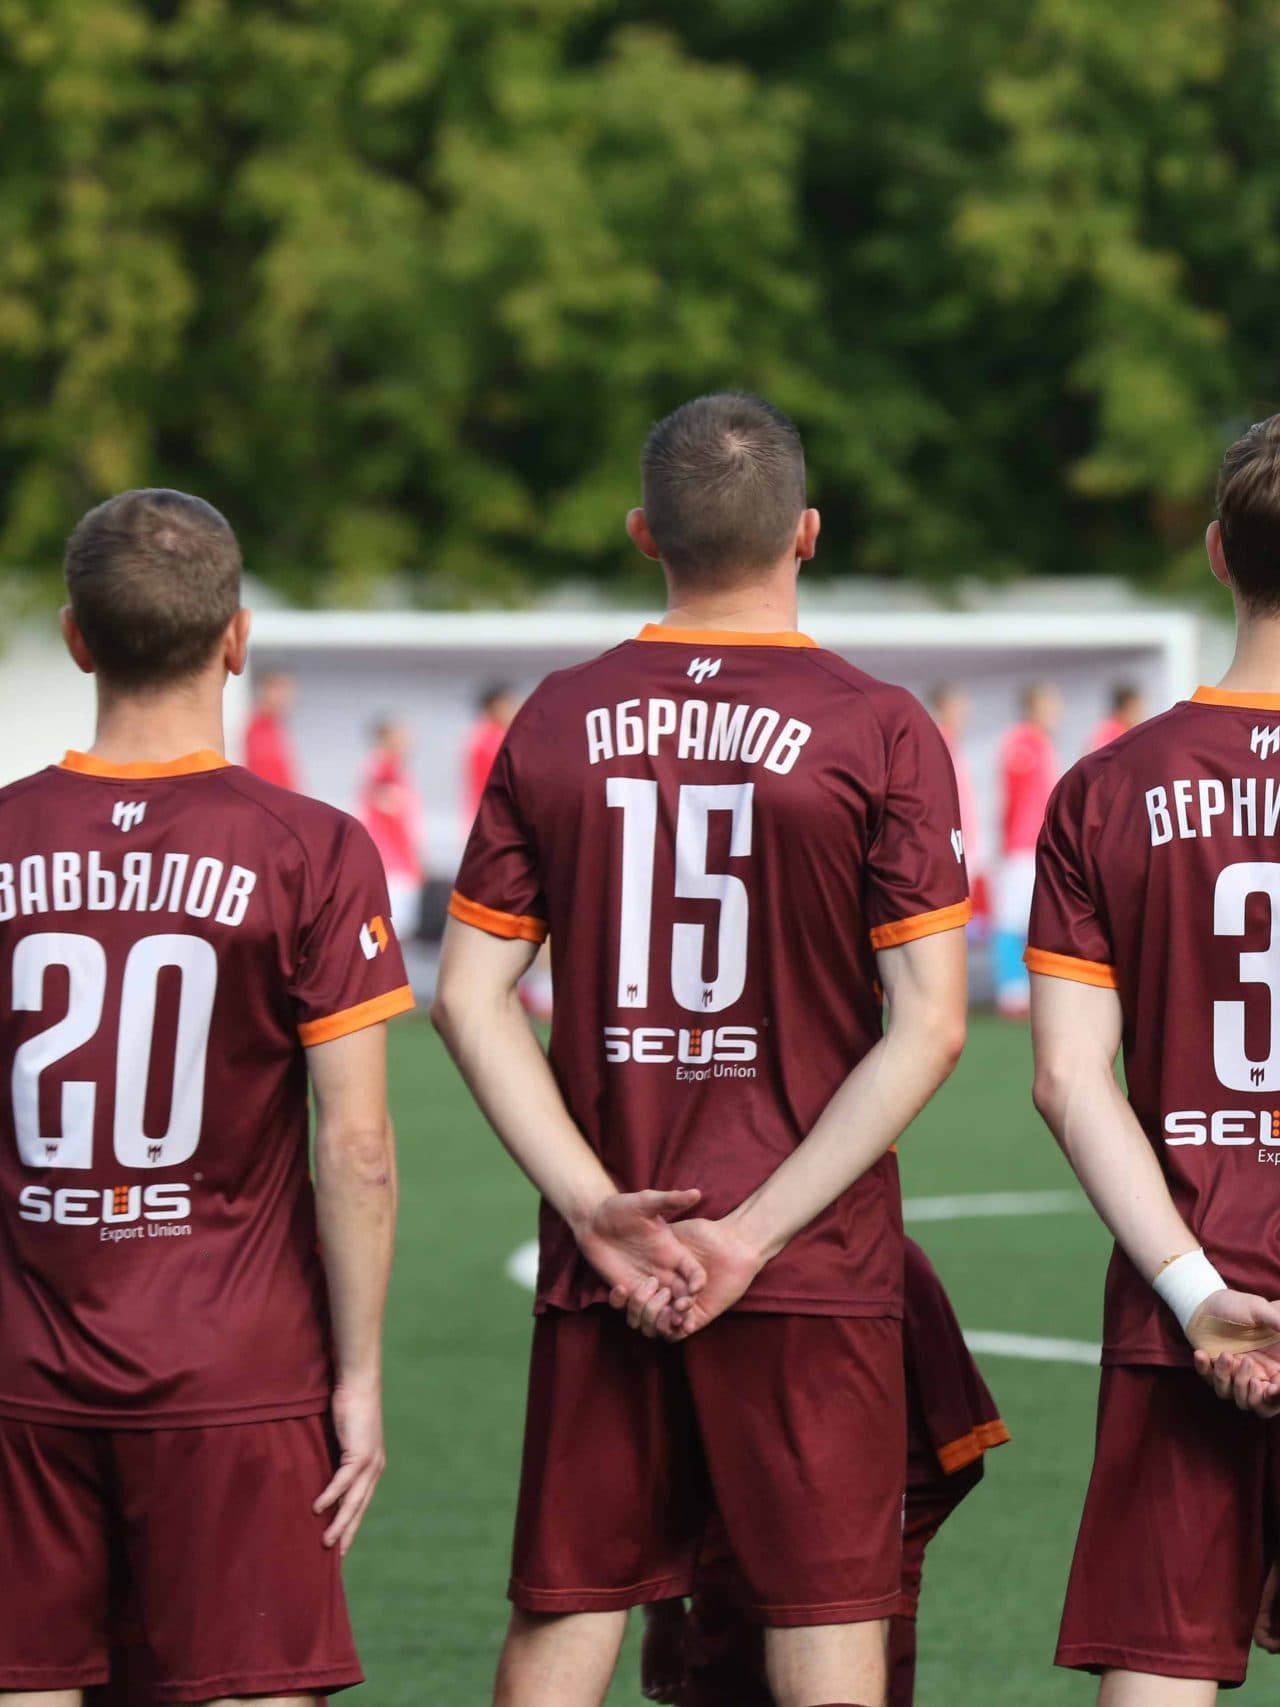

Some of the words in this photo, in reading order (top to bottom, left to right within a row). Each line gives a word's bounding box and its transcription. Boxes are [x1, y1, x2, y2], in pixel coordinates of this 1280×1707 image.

[585, 697, 812, 775] АБРАМОВ
[606, 776, 755, 1013] 15
[11, 932, 218, 1170] 20
[604, 1026, 758, 1064] SEUS
[713, 1064, 756, 1078] Union
[18, 1183, 191, 1226] SEUS
[100, 1226, 145, 1242] Export
[147, 1222, 192, 1238] Union
